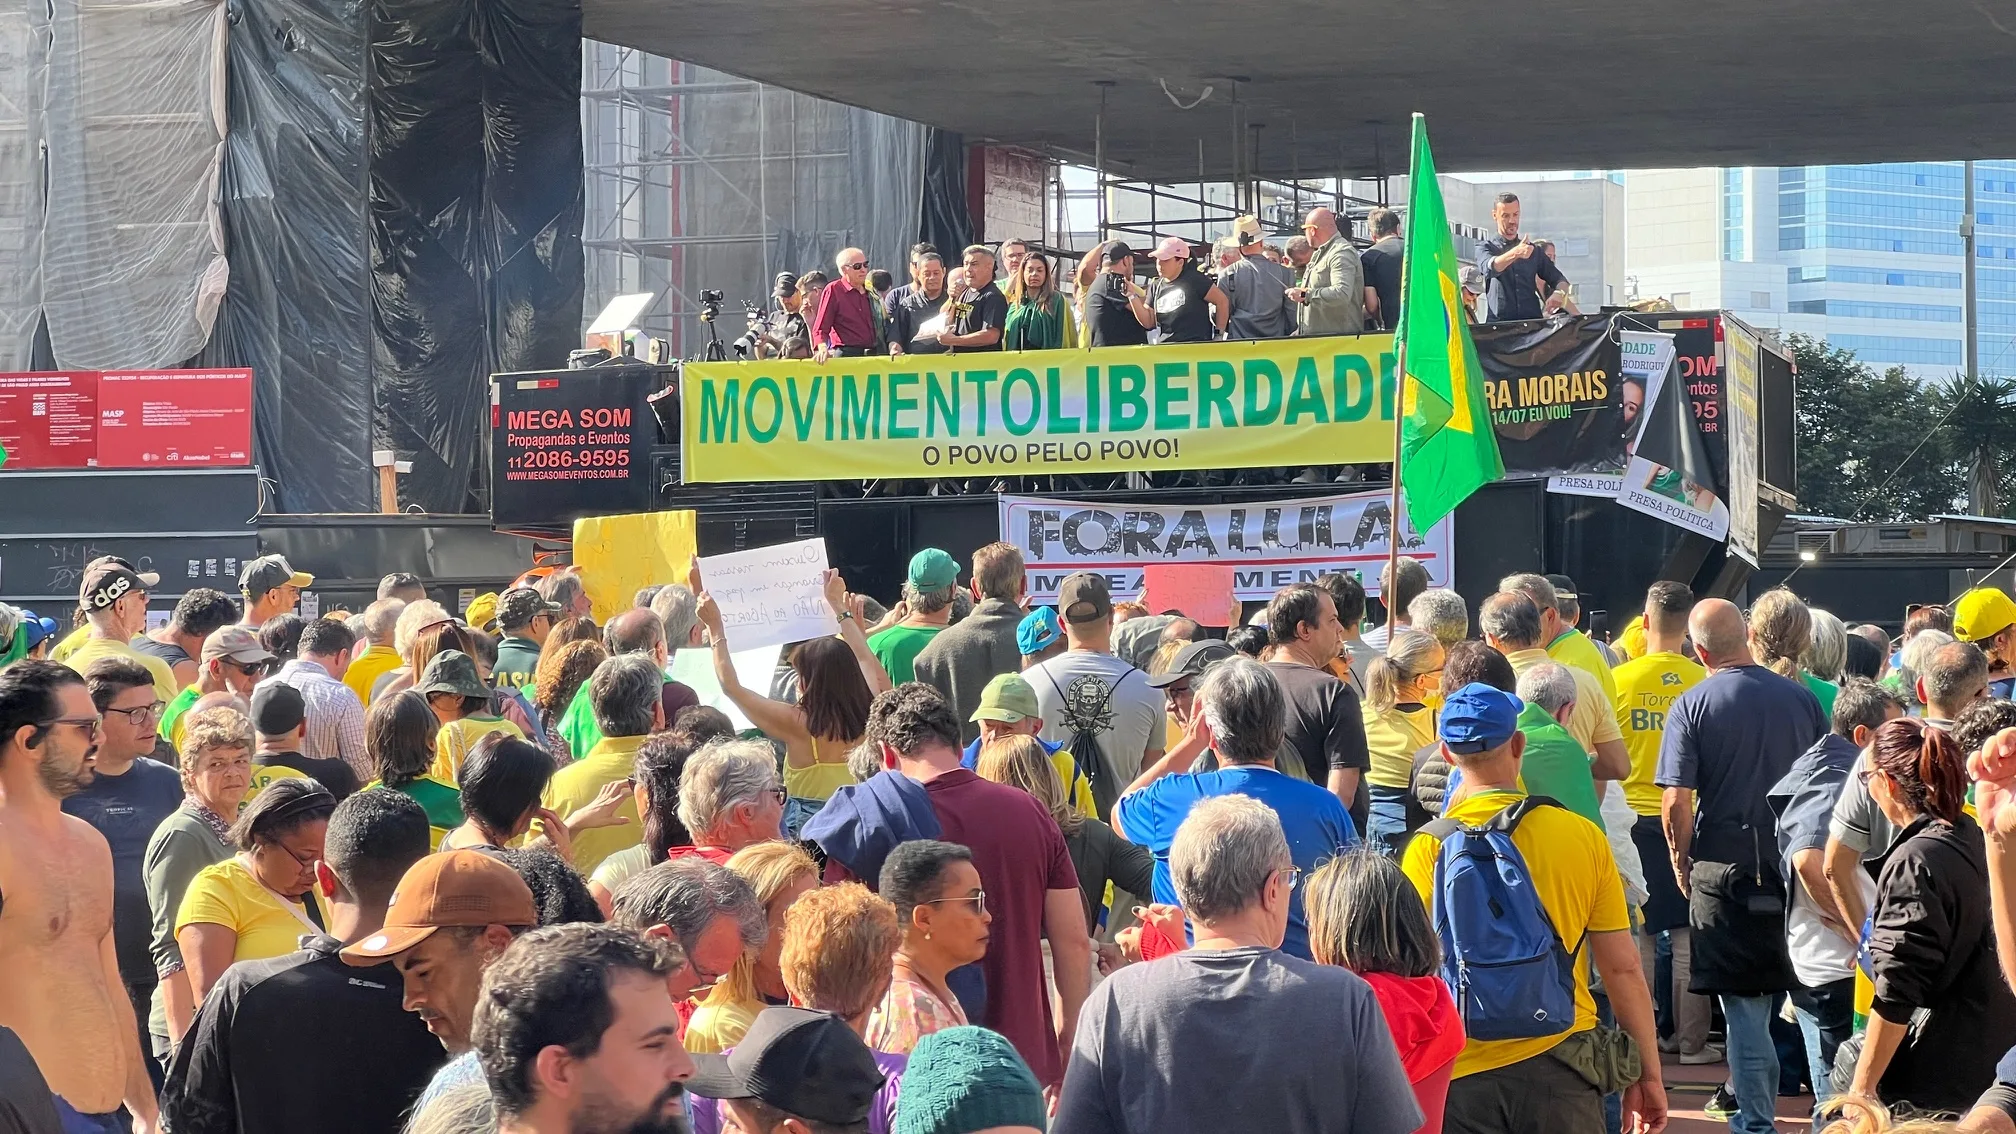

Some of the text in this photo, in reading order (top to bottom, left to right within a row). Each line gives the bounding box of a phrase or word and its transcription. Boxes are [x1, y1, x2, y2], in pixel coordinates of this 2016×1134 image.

[1678, 355, 1717, 377] OM
[1518, 369, 1608, 407] MORAIS
[1687, 381, 1718, 396] ntos
[102, 410, 124, 418] MASP
[508, 408, 631, 430] MEGA SOM
[1492, 404, 1572, 425] 14/07 EU VOU!
[508, 431, 631, 449] Propagandas e Eventos
[507, 449, 630, 469] 11 2086-9595
[922, 438, 1180, 466] O POVO PELO POVO!
[507, 469, 629, 481] WWW.MEGASOMEVENTOS.COM.BR
[1559, 477, 1593, 489] PRESA
[1628, 490, 1714, 531] PRESA POLÍTICA
[1028, 509, 1219, 560] FORA
[94, 576, 131, 607] das
[1637, 691, 1683, 707] Torc
